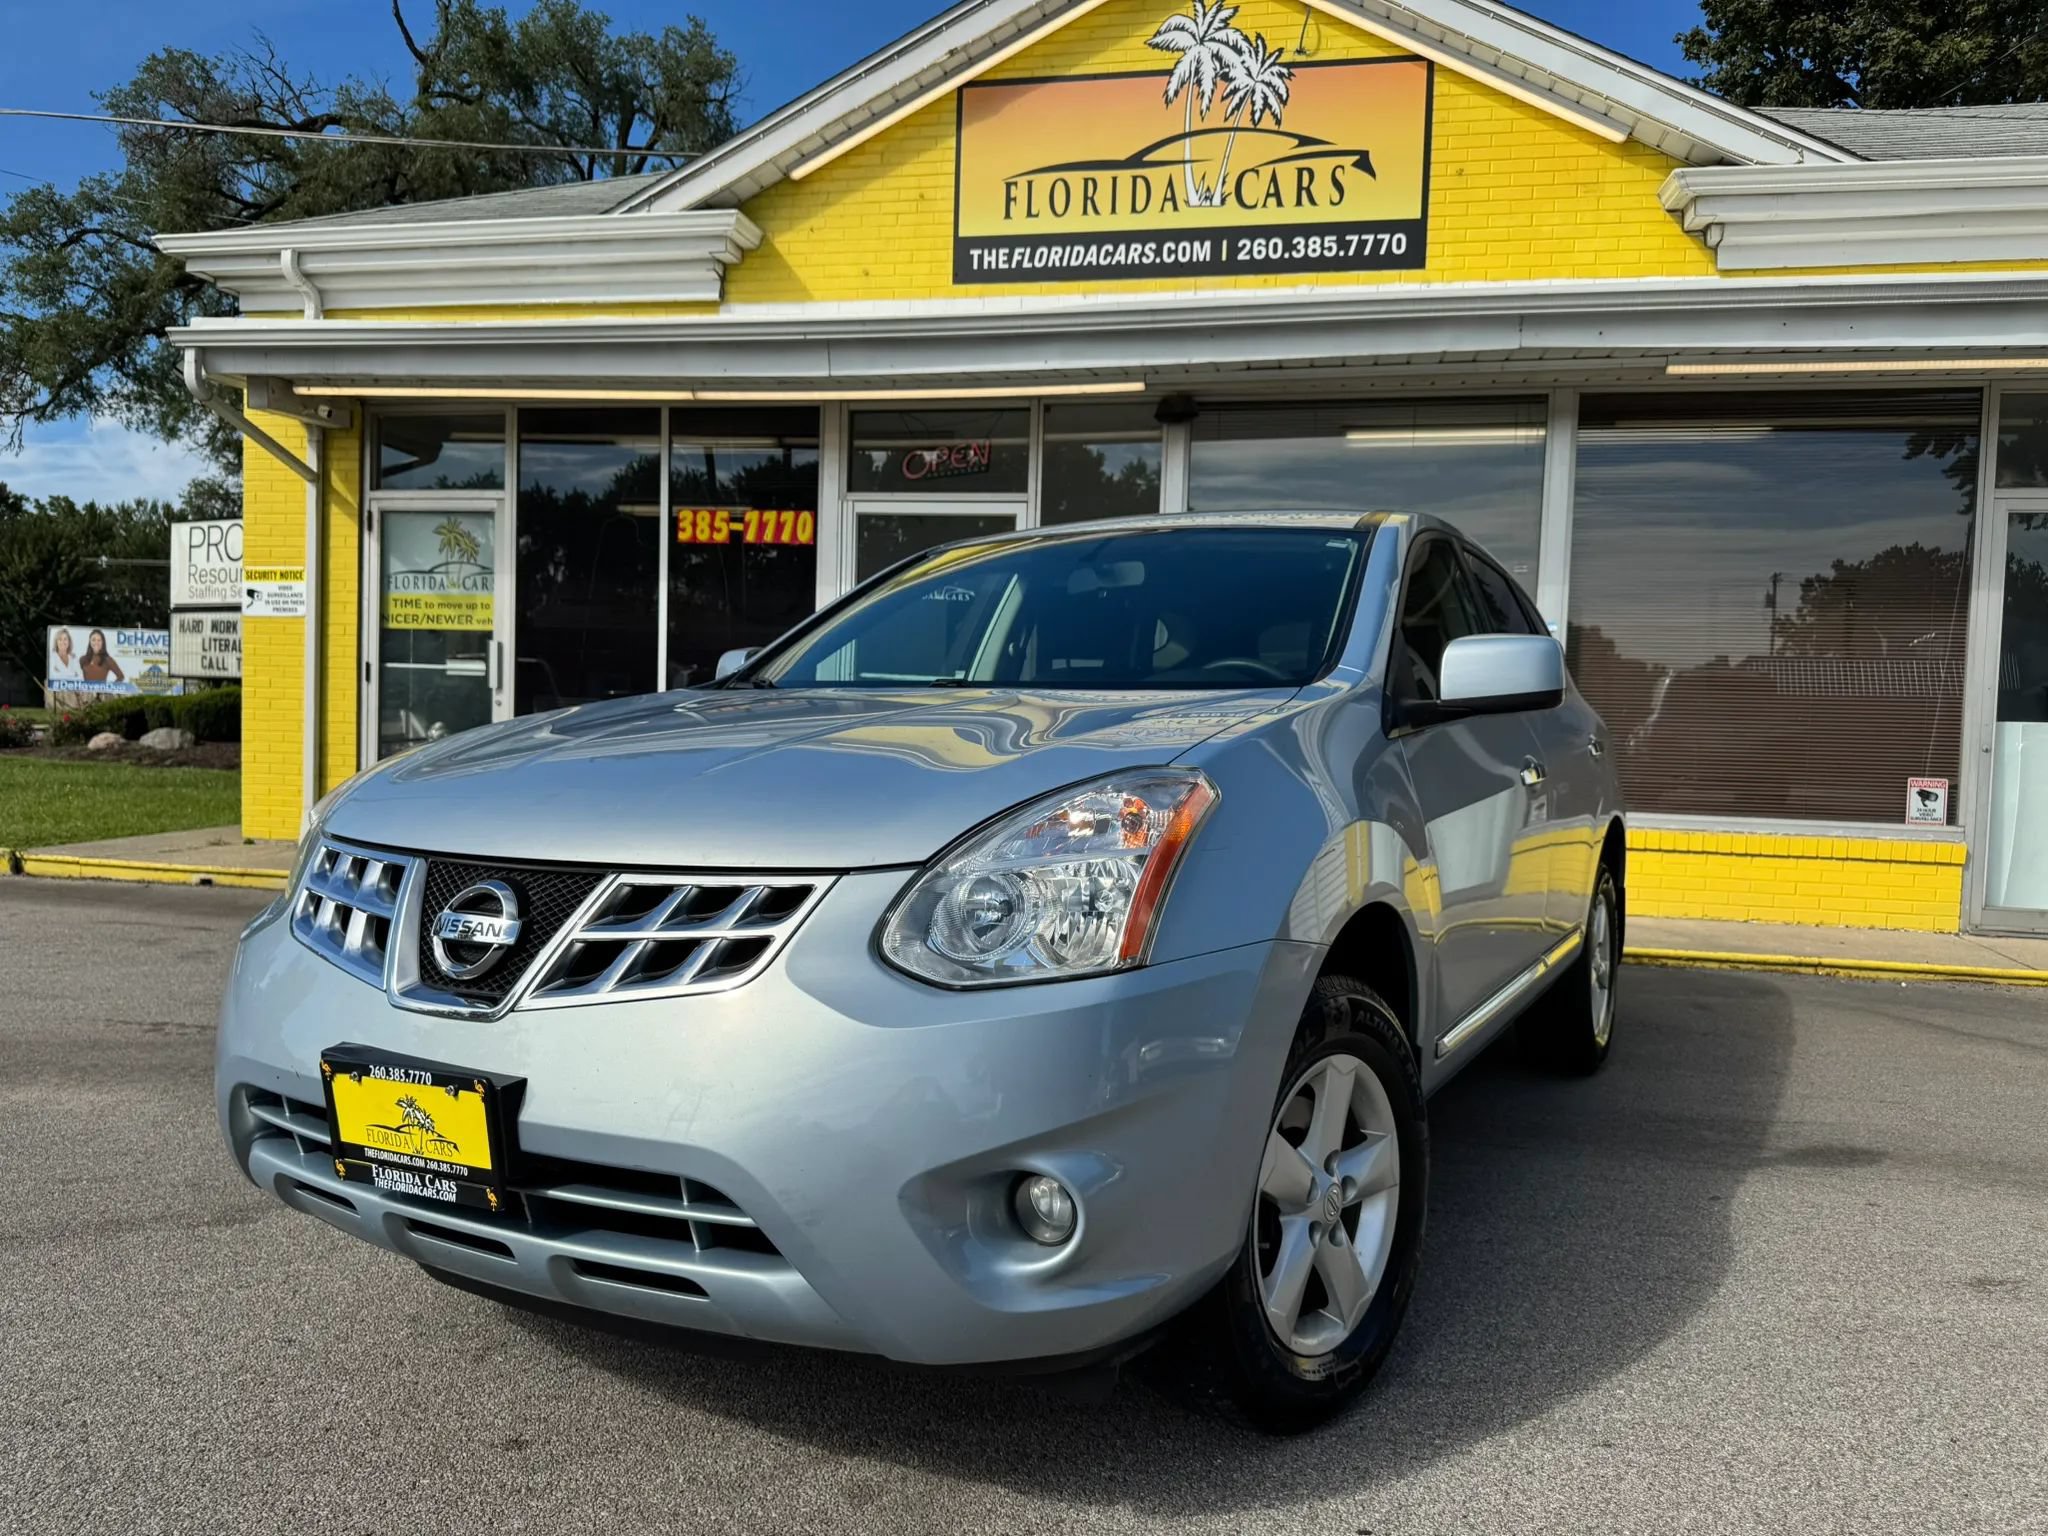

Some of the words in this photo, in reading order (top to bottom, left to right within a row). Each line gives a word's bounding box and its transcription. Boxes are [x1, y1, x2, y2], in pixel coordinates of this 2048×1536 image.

[1003, 172, 1180, 221] FLORIDA
[1234, 164, 1346, 211] CARS
[970, 239, 1211, 271] THEFLORIDACARS.COM
[1237, 232, 1408, 262] 260.385.7770
[902, 439, 989, 480] OPEN
[677, 509, 814, 542] 385-7770
[245, 570, 277, 581] SECURITY
[280, 570, 304, 580] NOTICE
[387, 575, 446, 591] FLORIDA
[188, 585, 227, 602] Staffing
[391, 598, 422, 609] TIME
[425, 601, 435, 610] to
[437, 602, 464, 610] move
[466, 602, 478, 613] up
[480, 601, 491, 610] to
[178, 619, 204, 634] HARD
[211, 619, 238, 634] WORK
[382, 613, 474, 626] NICER/NEWER
[201, 655, 229, 672] CALL
[1910, 780, 1946, 788] WARNING
[437, 917, 503, 938] NISSAN
[368, 1064, 432, 1086] 260.385.7770
[365, 1127, 412, 1150] FLORIDA
[425, 1138, 454, 1158] CARS
[364, 1147, 426, 1168] THEFLORIDACARS.COM
[426, 1159, 469, 1177] 260.385.7770
[374, 1177, 457, 1203] THEFLORIDACARS.COM
